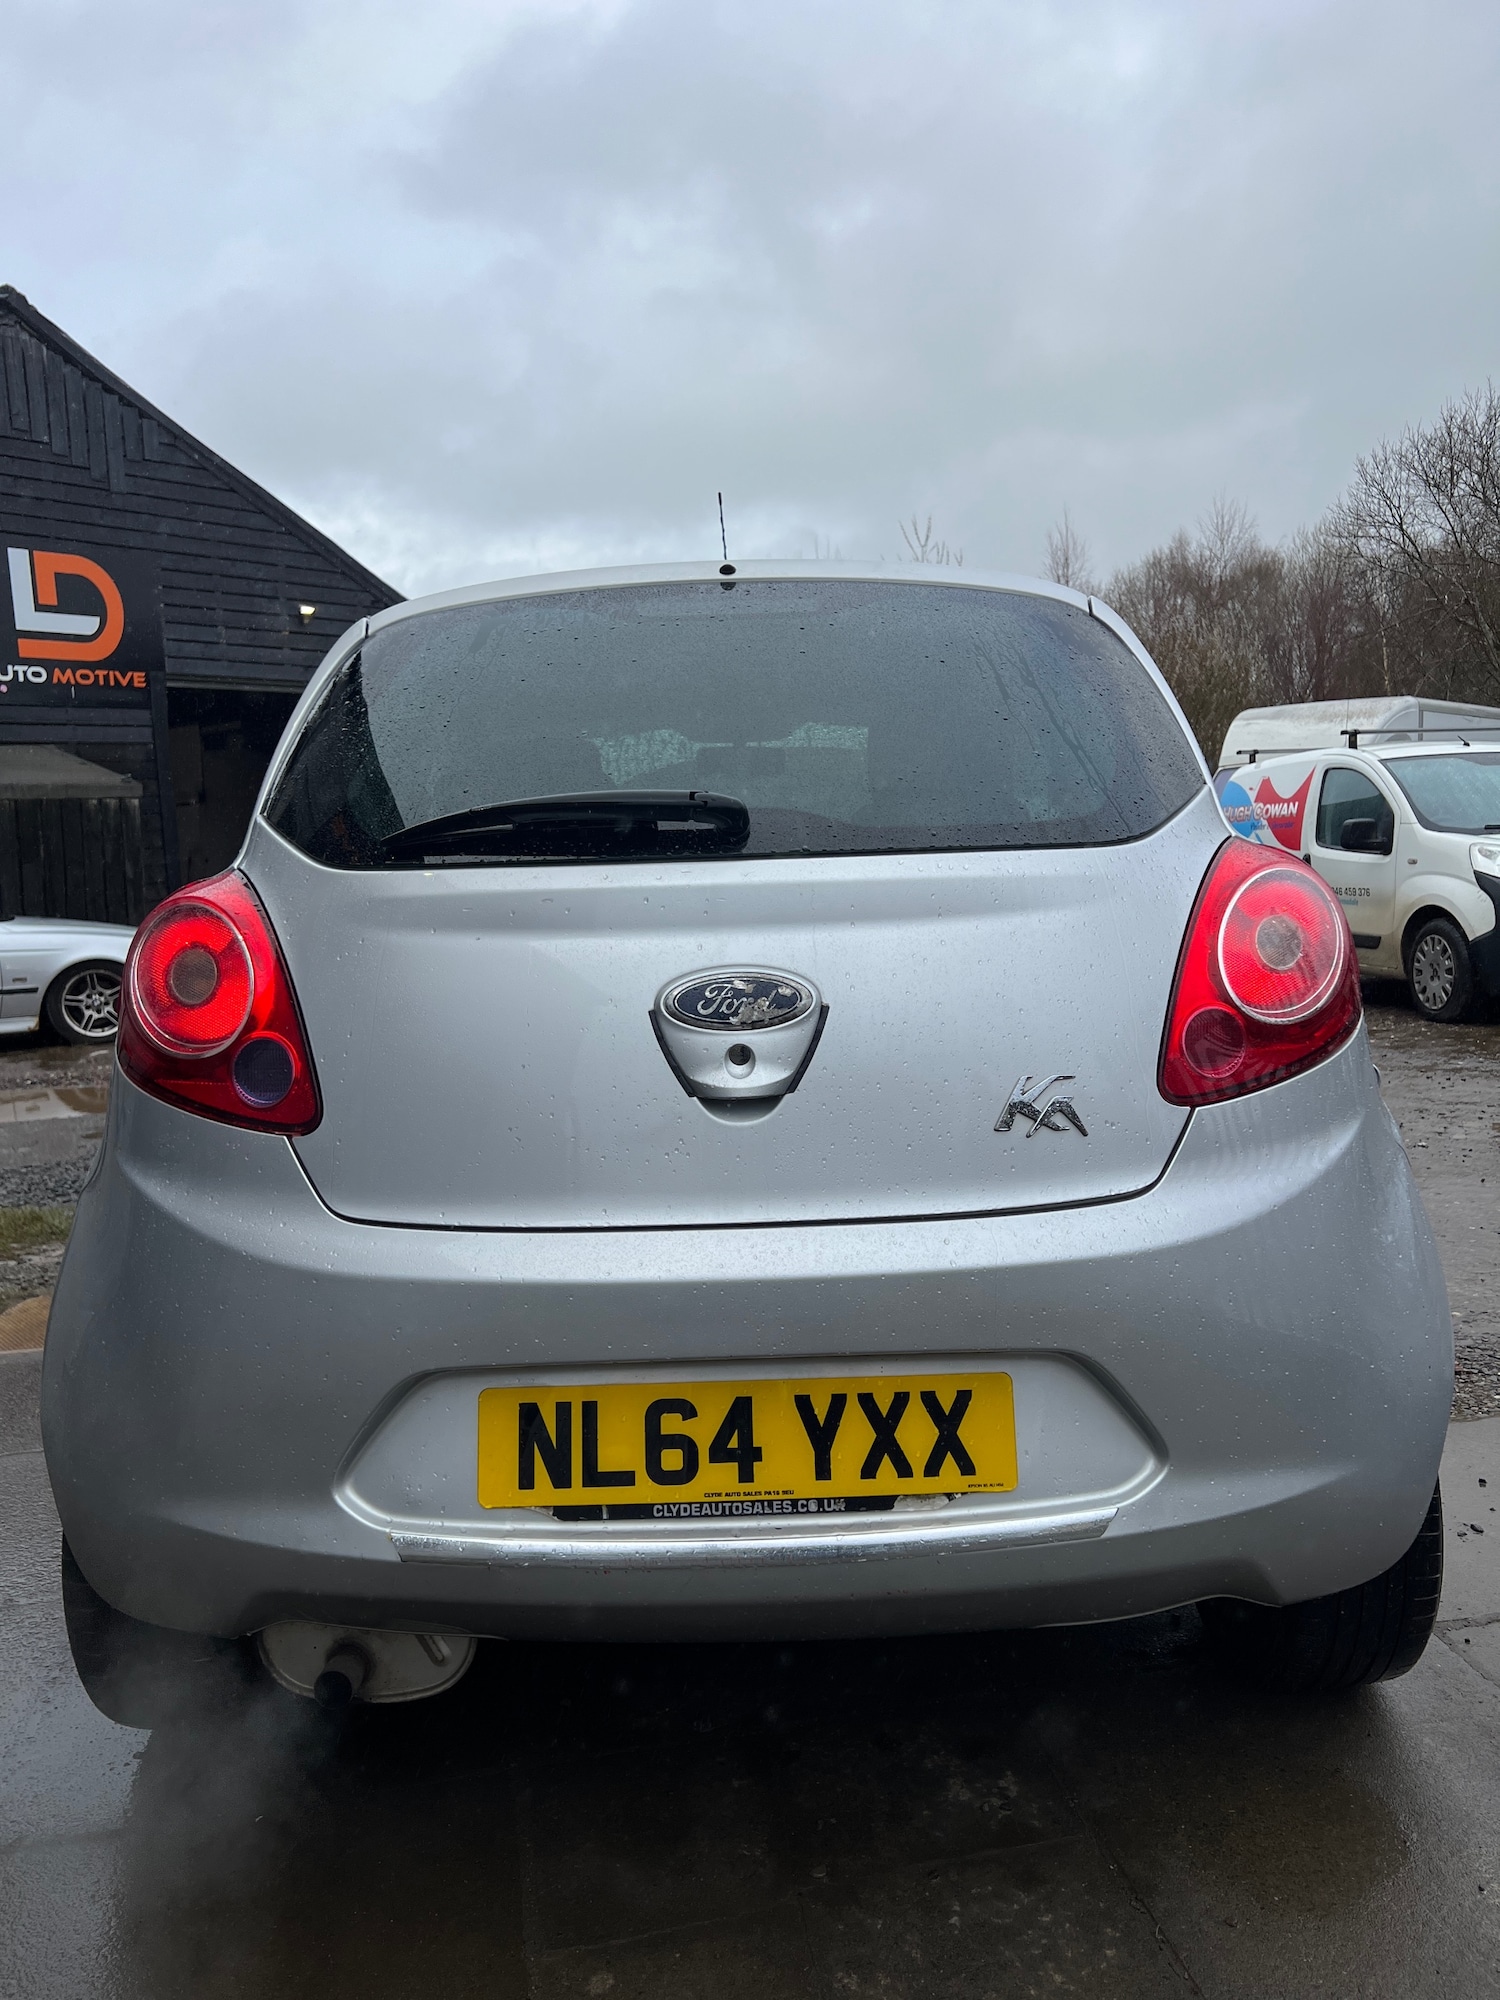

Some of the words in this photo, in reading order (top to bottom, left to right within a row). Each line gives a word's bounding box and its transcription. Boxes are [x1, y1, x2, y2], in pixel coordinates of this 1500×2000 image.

[52, 667, 147, 688] MOTIVE
[1223, 806, 1252, 821] HUGH
[1344, 887, 1356, 896] 459
[1358, 887, 1370, 897] 376
[695, 983, 776, 1015] Ford
[517, 1396, 763, 1491] NL64
[794, 1390, 977, 1482] YXX
[653, 1499, 846, 1517] CLYDEAUTOSALES.CO.UK
